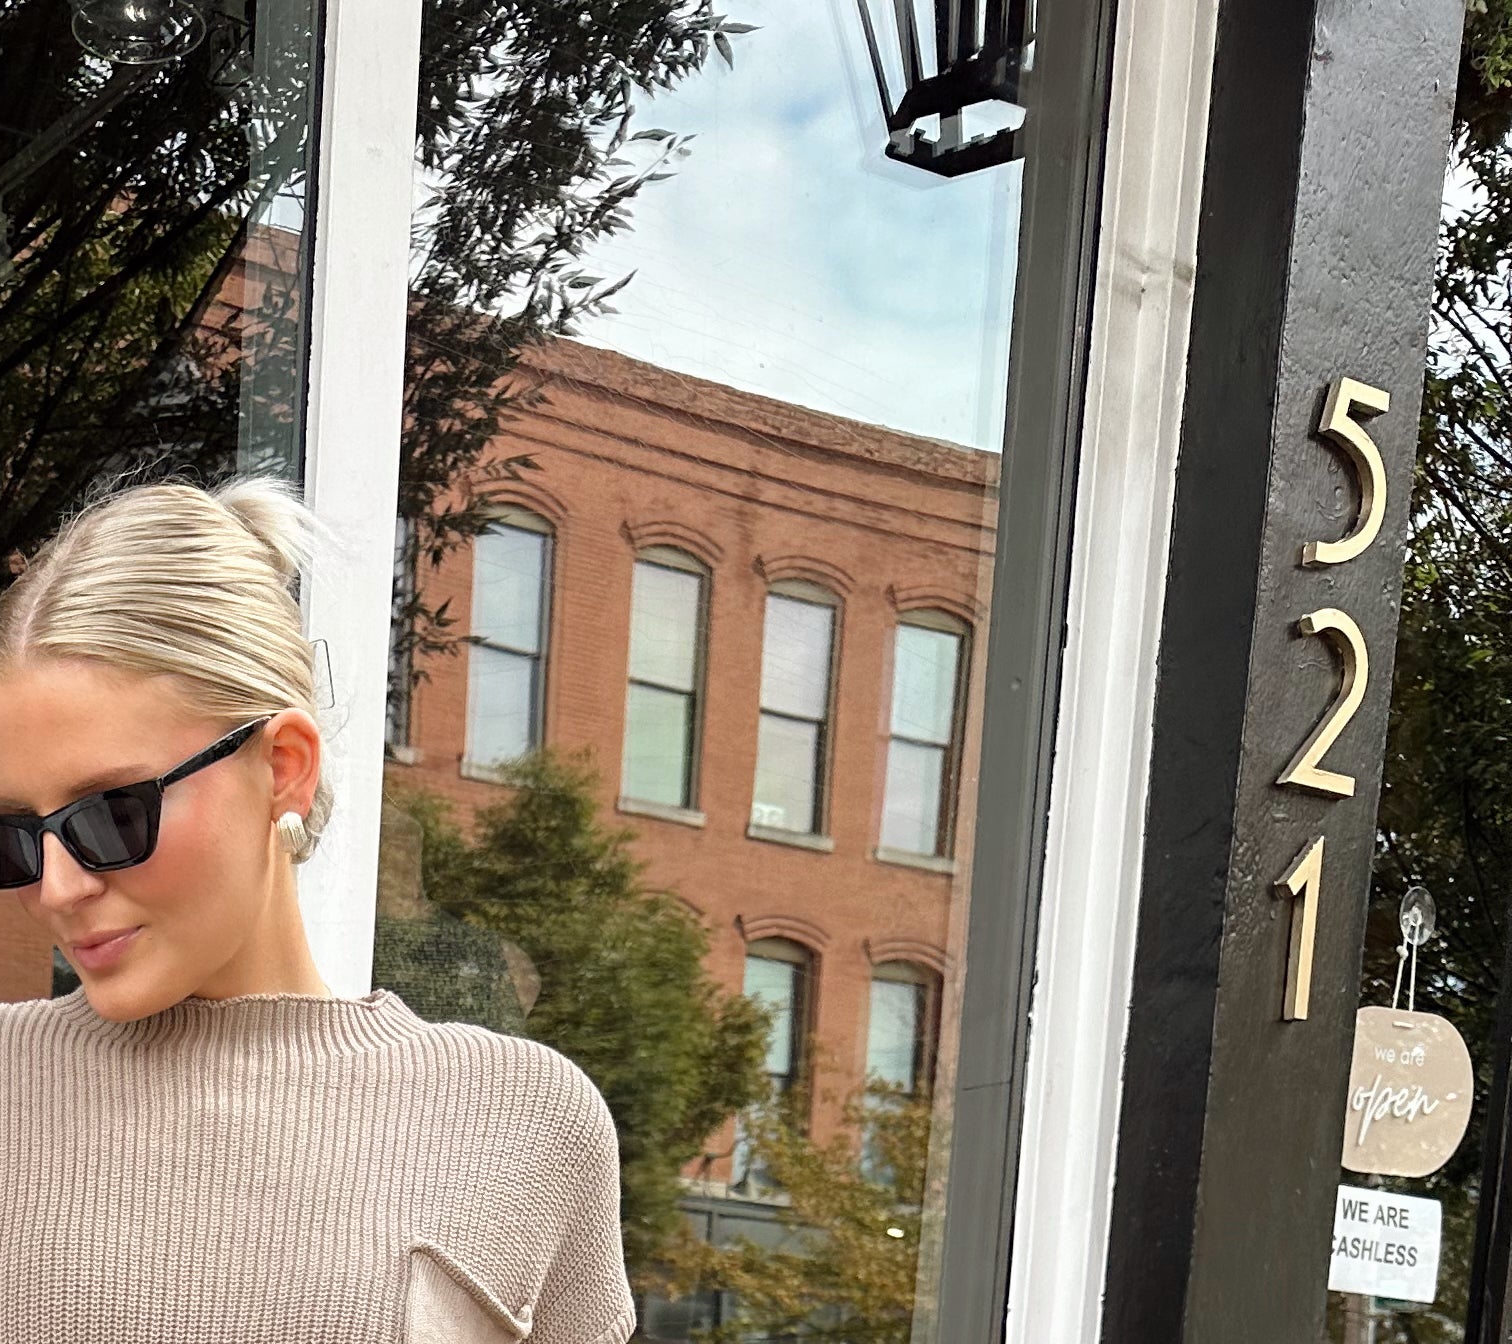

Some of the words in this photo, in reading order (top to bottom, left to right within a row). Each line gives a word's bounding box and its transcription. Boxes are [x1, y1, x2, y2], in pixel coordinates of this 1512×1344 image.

[1278, 376, 1390, 1021] 521
[1374, 1045, 1396, 1063] we
[1400, 1048, 1425, 1067] are
[1352, 1073, 1439, 1146] open
[1342, 1198, 1369, 1223] WE
[1373, 1204, 1410, 1230] ARE
[1330, 1234, 1418, 1268] ASHLESS
